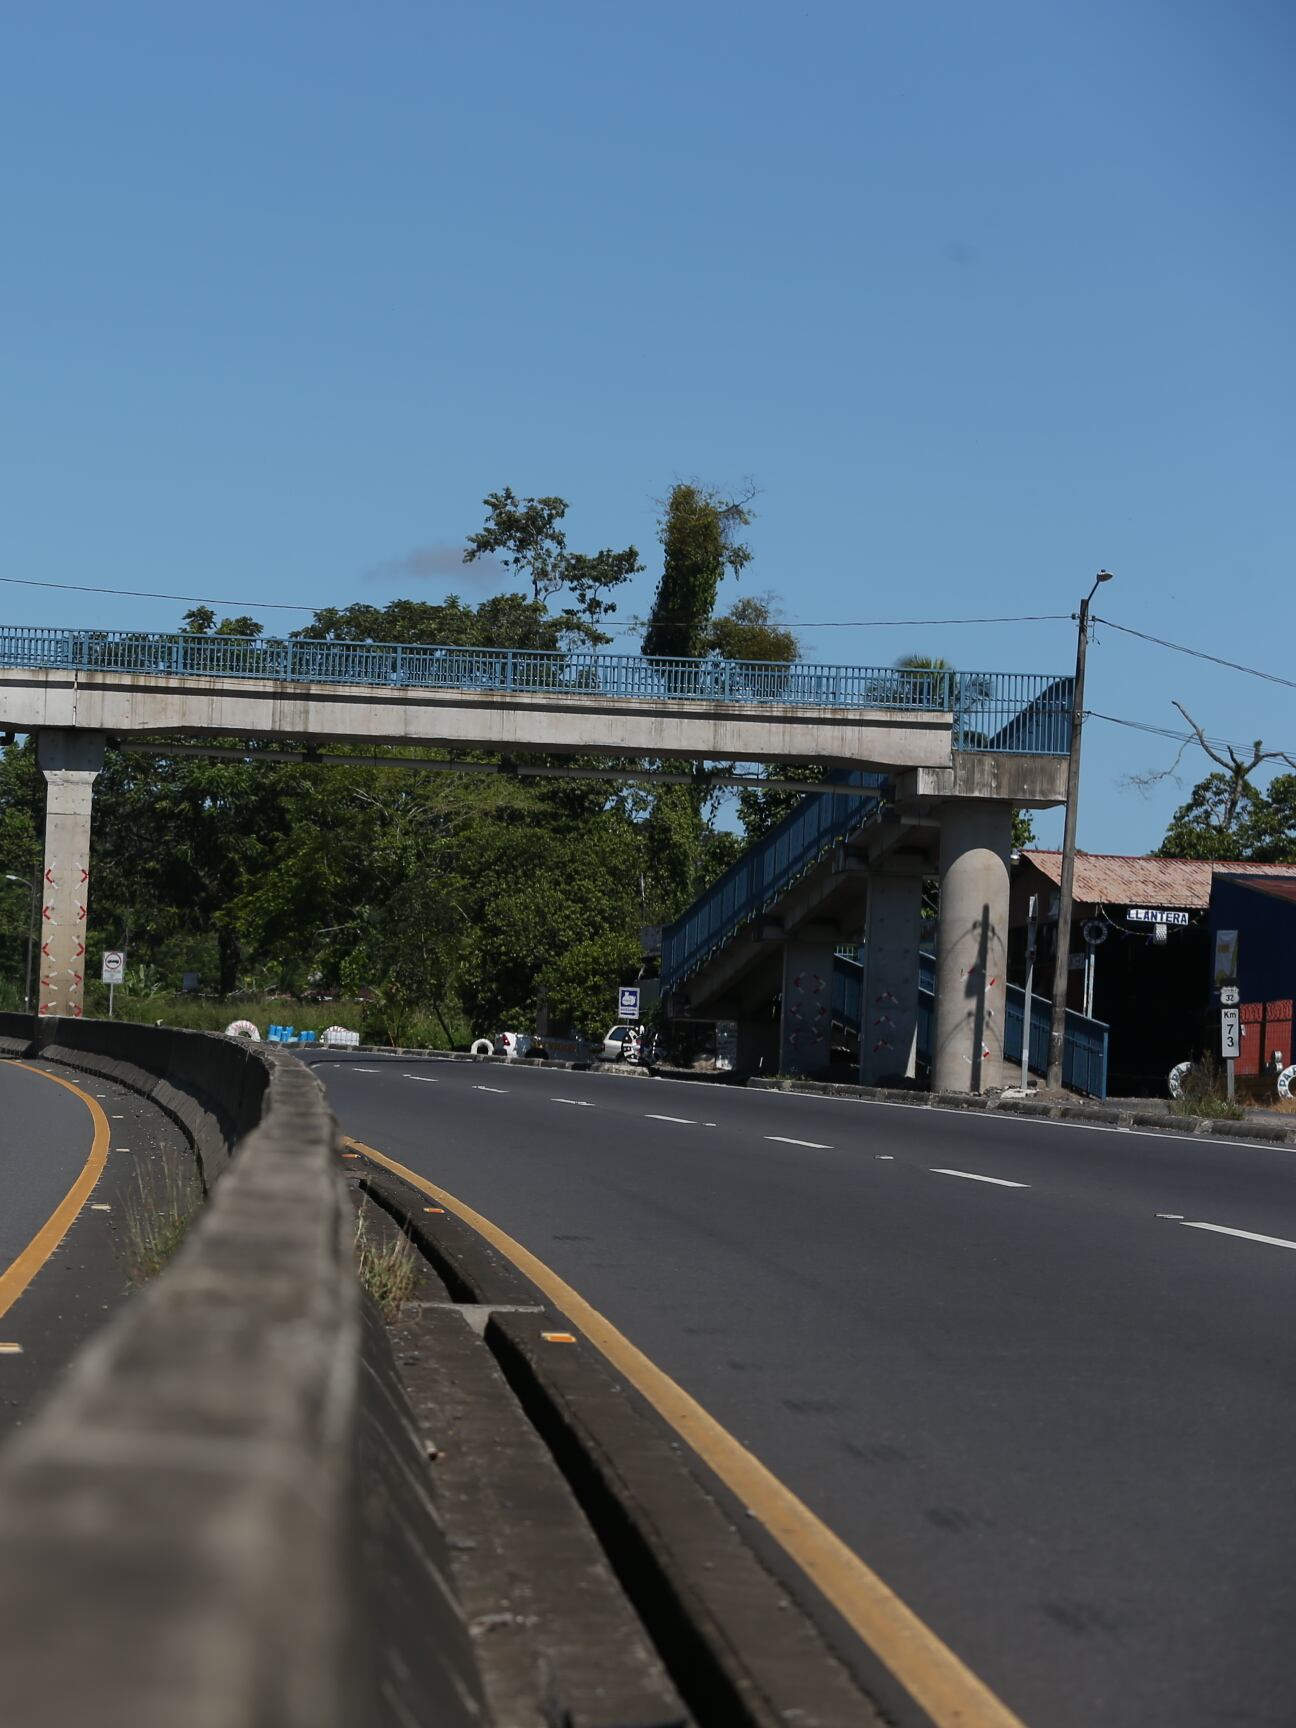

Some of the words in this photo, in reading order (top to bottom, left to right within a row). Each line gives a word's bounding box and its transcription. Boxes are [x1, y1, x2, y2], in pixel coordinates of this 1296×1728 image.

[1127, 908, 1187, 923] LLANTERA
[1225, 994, 1234, 1002] 32
[1224, 1011, 1237, 1019] Km
